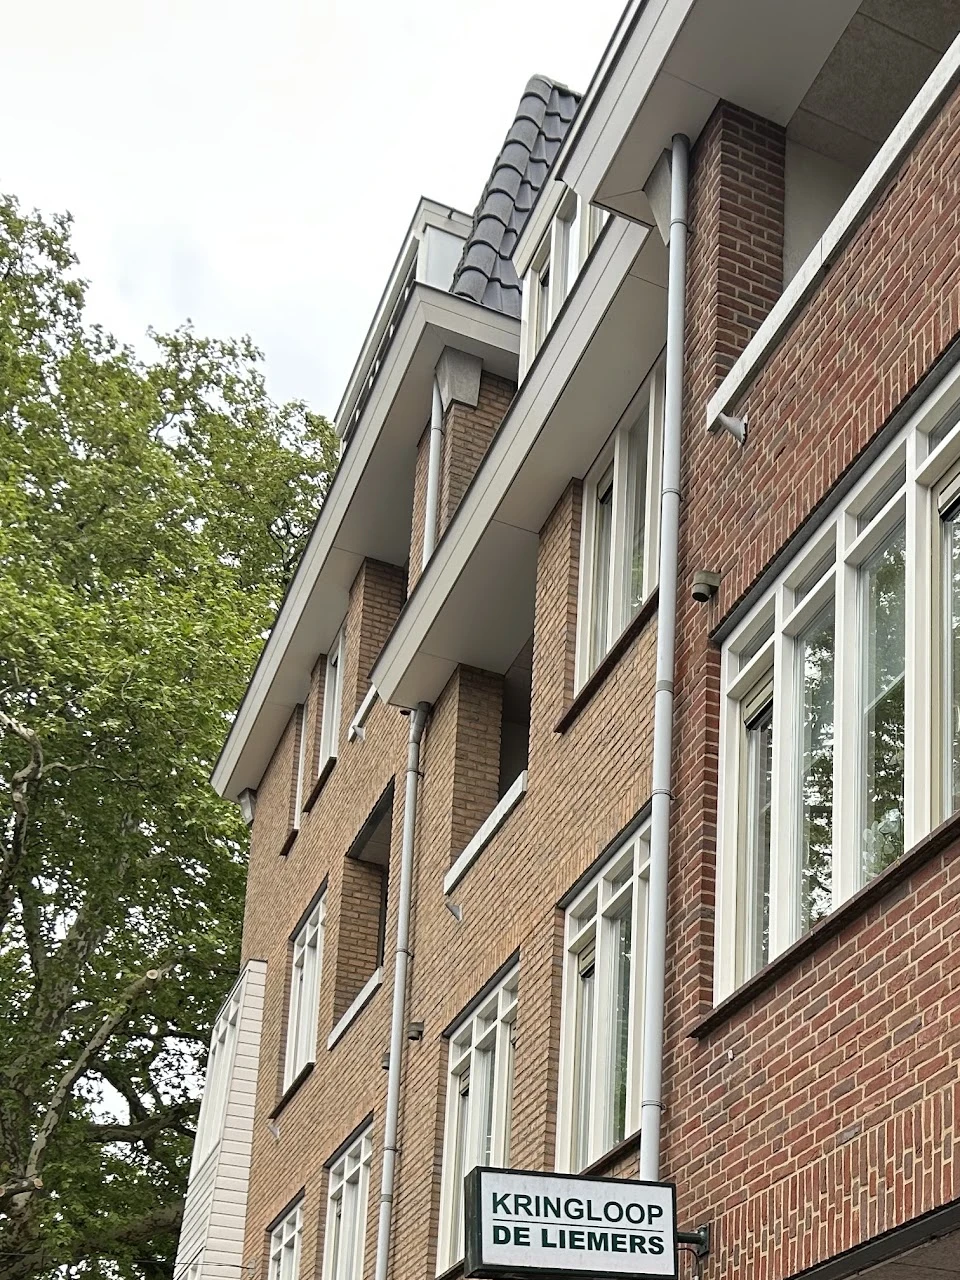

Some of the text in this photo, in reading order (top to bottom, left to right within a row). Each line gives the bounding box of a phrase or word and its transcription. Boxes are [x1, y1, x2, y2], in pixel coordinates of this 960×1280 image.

[492, 1192, 663, 1225] KRINGLOOP
[493, 1225, 665, 1255] DE LIEMERS
